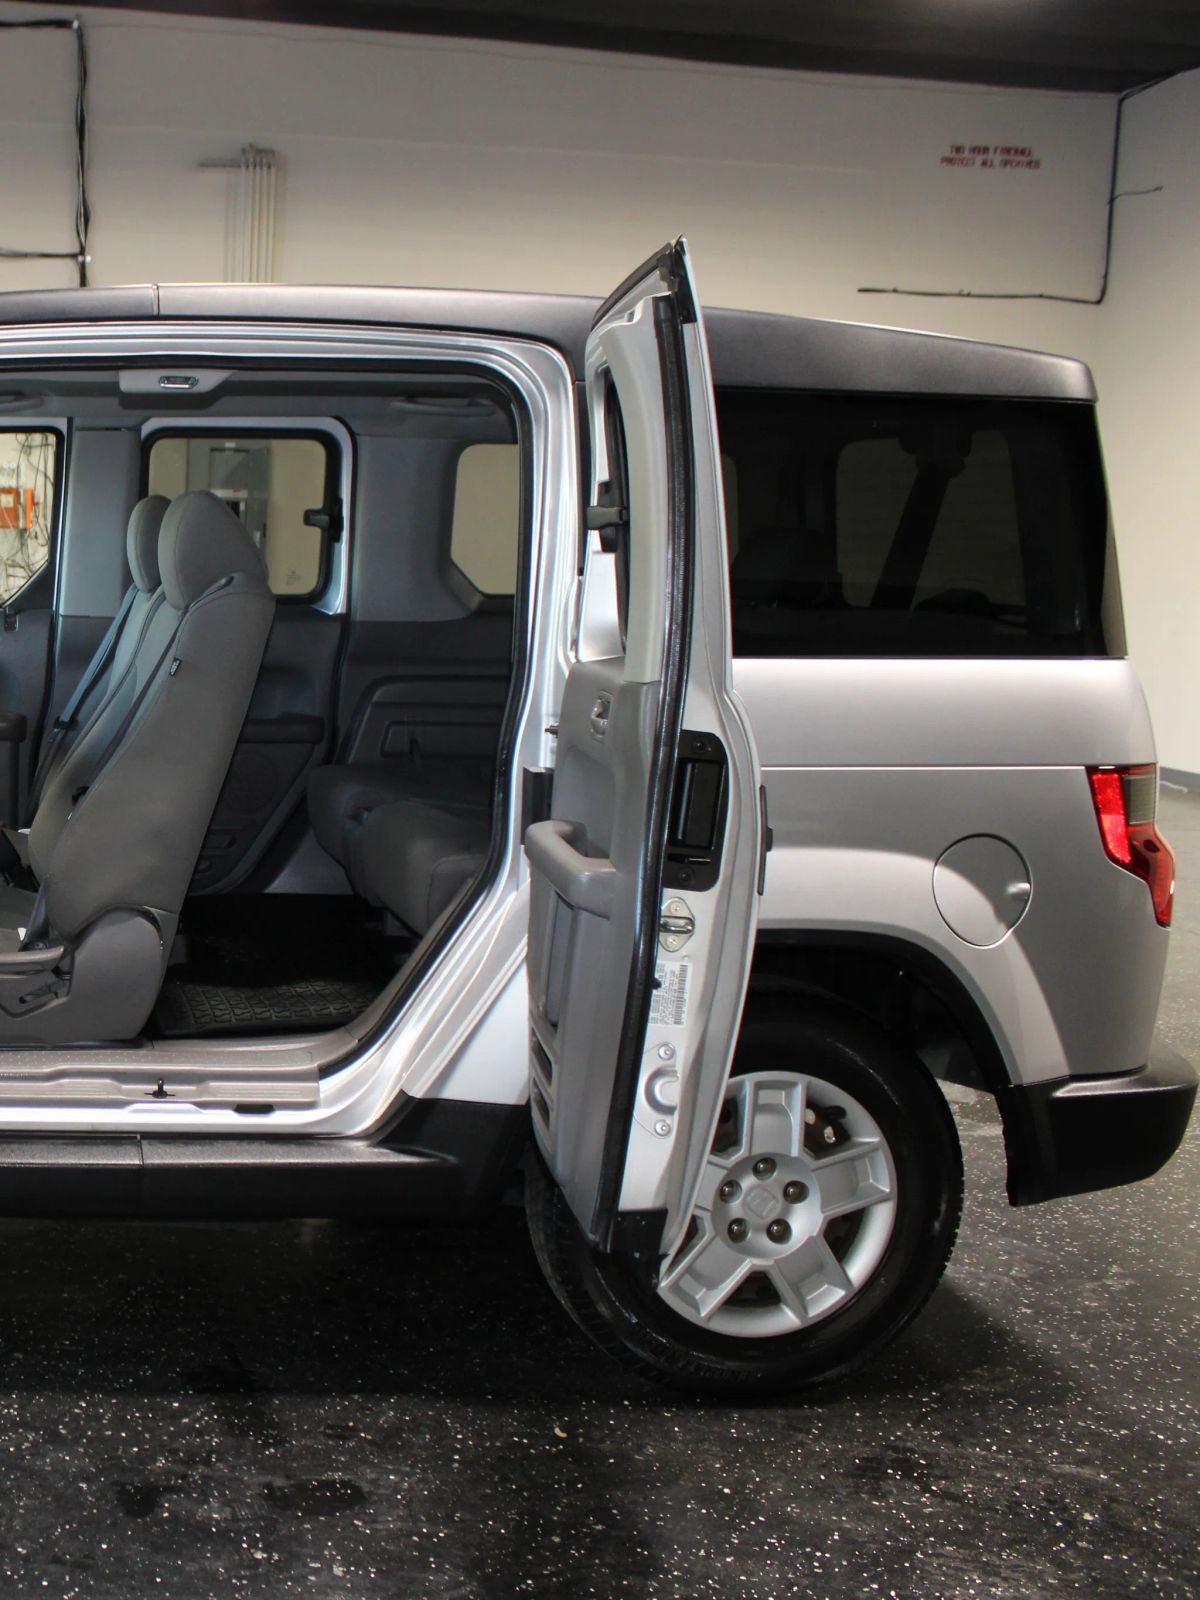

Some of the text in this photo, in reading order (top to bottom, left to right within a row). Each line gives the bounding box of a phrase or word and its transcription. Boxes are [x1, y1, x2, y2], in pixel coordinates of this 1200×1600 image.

[950, 145, 965, 154] TWO
[968, 145, 990, 155] HOUR
[941, 156, 976, 167] PROTECT
[981, 158, 994, 168] ALL
